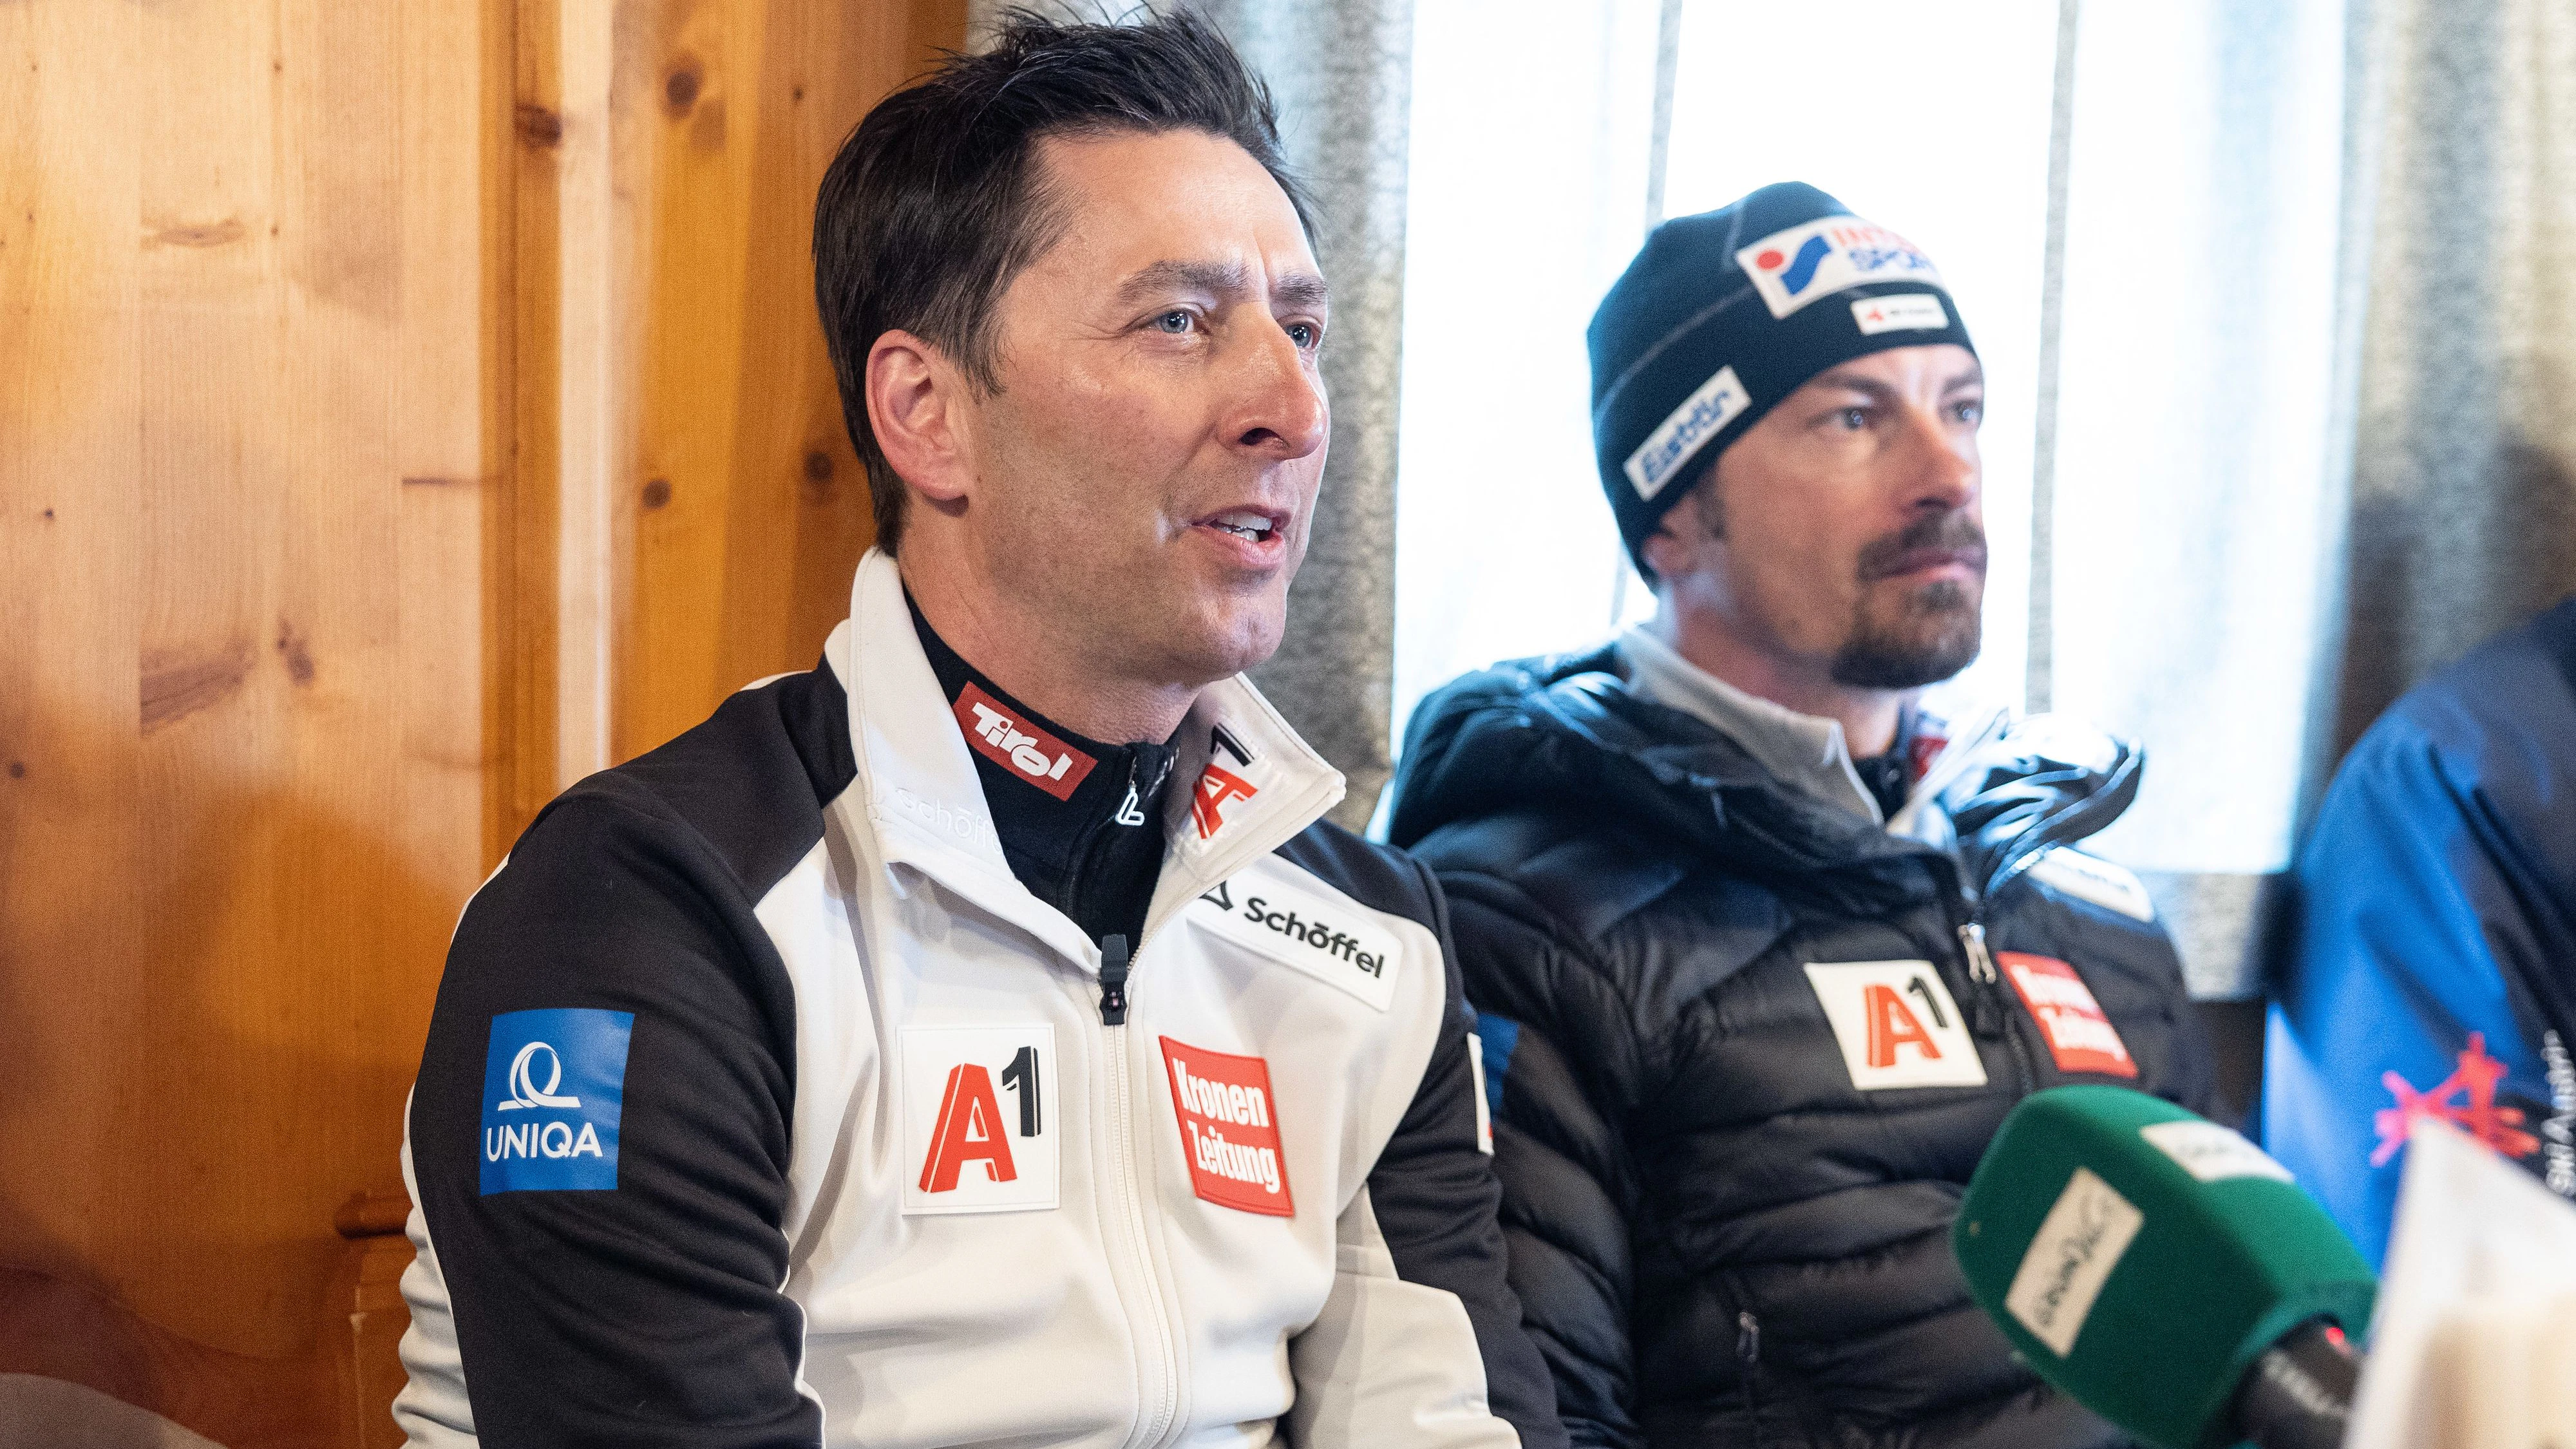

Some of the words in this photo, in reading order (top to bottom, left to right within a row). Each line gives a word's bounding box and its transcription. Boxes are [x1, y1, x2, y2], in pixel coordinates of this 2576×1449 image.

[972, 701, 1074, 781] Tirol
[1191, 723, 1258, 840] A1
[1865, 974, 1949, 1068] A1
[919, 1045, 1042, 1193] A1
[1172, 1057, 1270, 1128] Kronen
[486, 1121, 603, 1162] UNIQA
[1186, 1121, 1282, 1194] Zeitung
